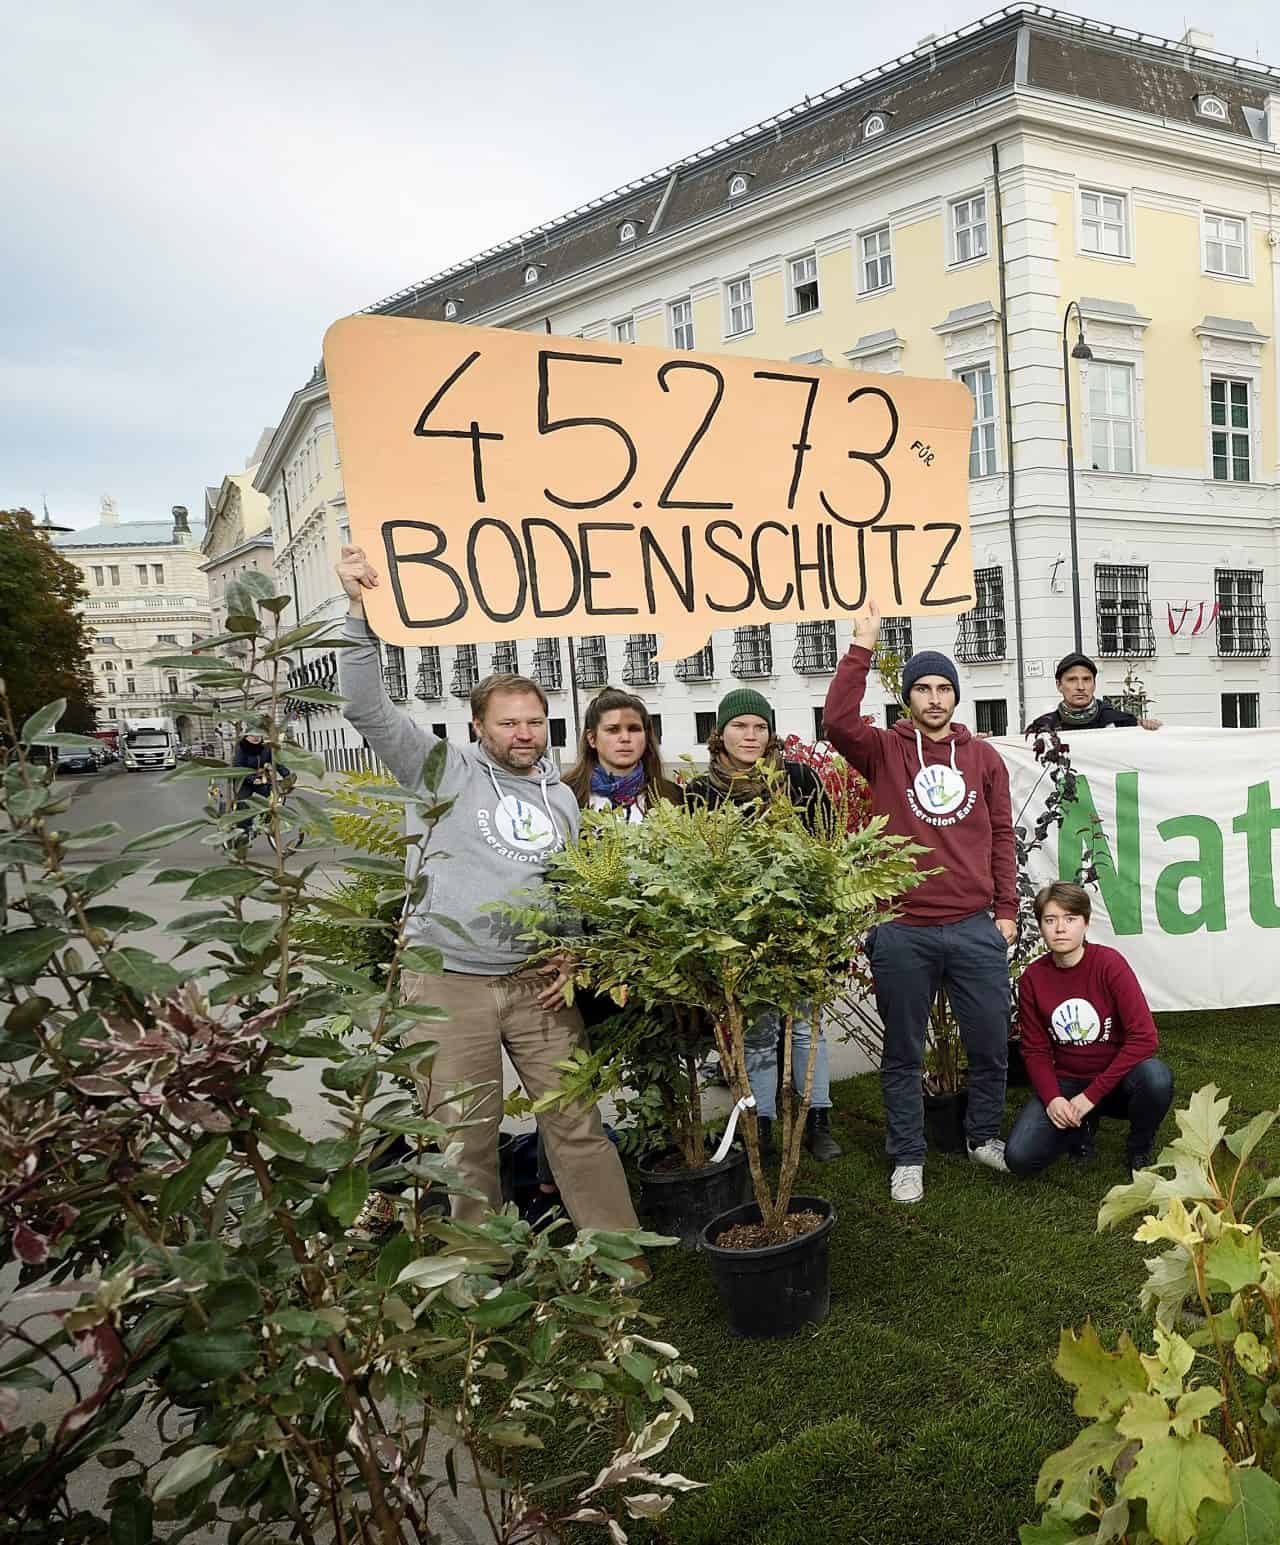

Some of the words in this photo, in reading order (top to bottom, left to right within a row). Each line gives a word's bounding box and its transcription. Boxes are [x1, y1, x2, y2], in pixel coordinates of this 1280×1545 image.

[413, 350, 900, 528] 45.273
[910, 440, 935, 467] FÜR
[381, 518, 972, 629] BODENSCHUTZ
[477, 808, 538, 862] Generation
[956, 790, 977, 820] Earth
